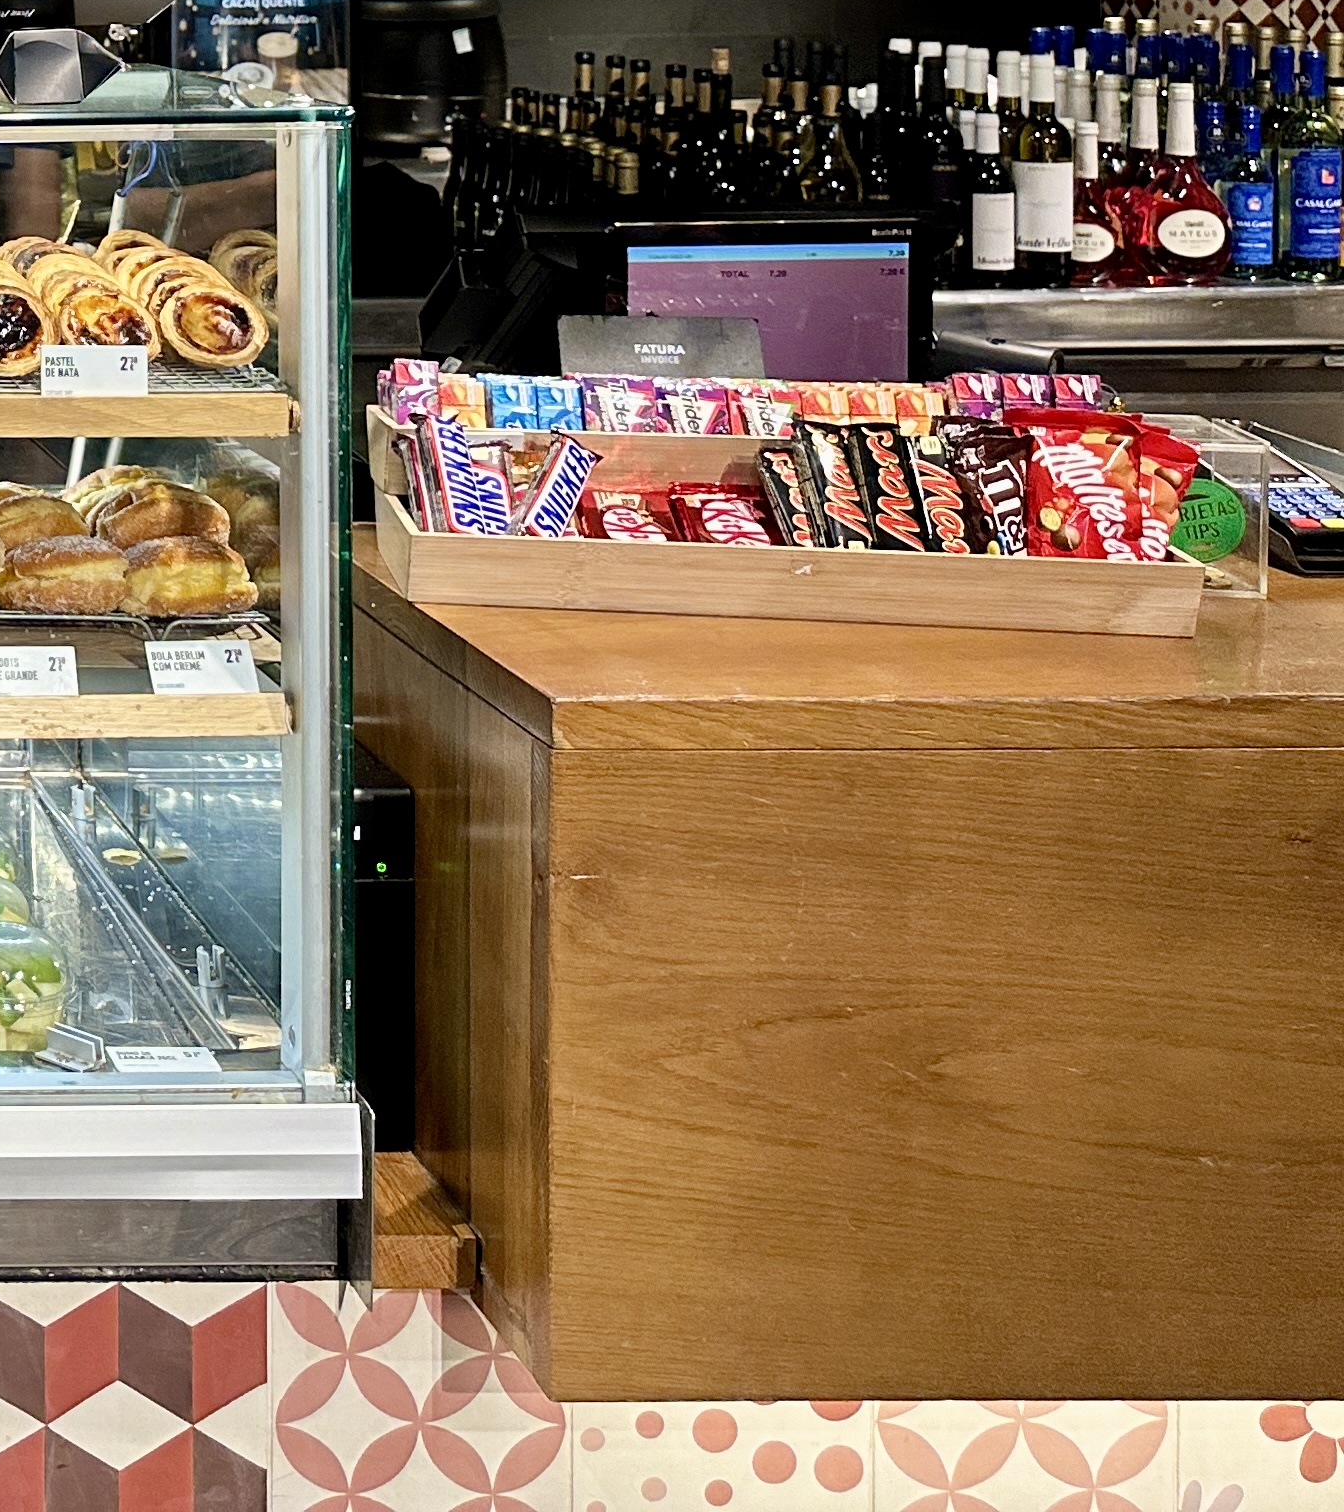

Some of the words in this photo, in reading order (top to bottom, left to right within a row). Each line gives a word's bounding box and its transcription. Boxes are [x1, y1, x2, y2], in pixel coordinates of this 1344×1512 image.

[1168, 229, 1218, 239] MATEUS
[719, 269, 750, 278] TOTAL
[633, 343, 686, 356] FATURA
[44, 356, 75, 367] PASTEL
[640, 356, 680, 365] INVOICE
[45, 367, 56, 378] DE
[58, 367, 80, 378] NATA
[1180, 498, 1238, 523] RJETAS
[1183, 522, 1221, 540] TIPS
[150, 650, 173, 661] BOLA
[174, 660, 203, 671] CREME
[4, 669, 39, 681] GRANDE
